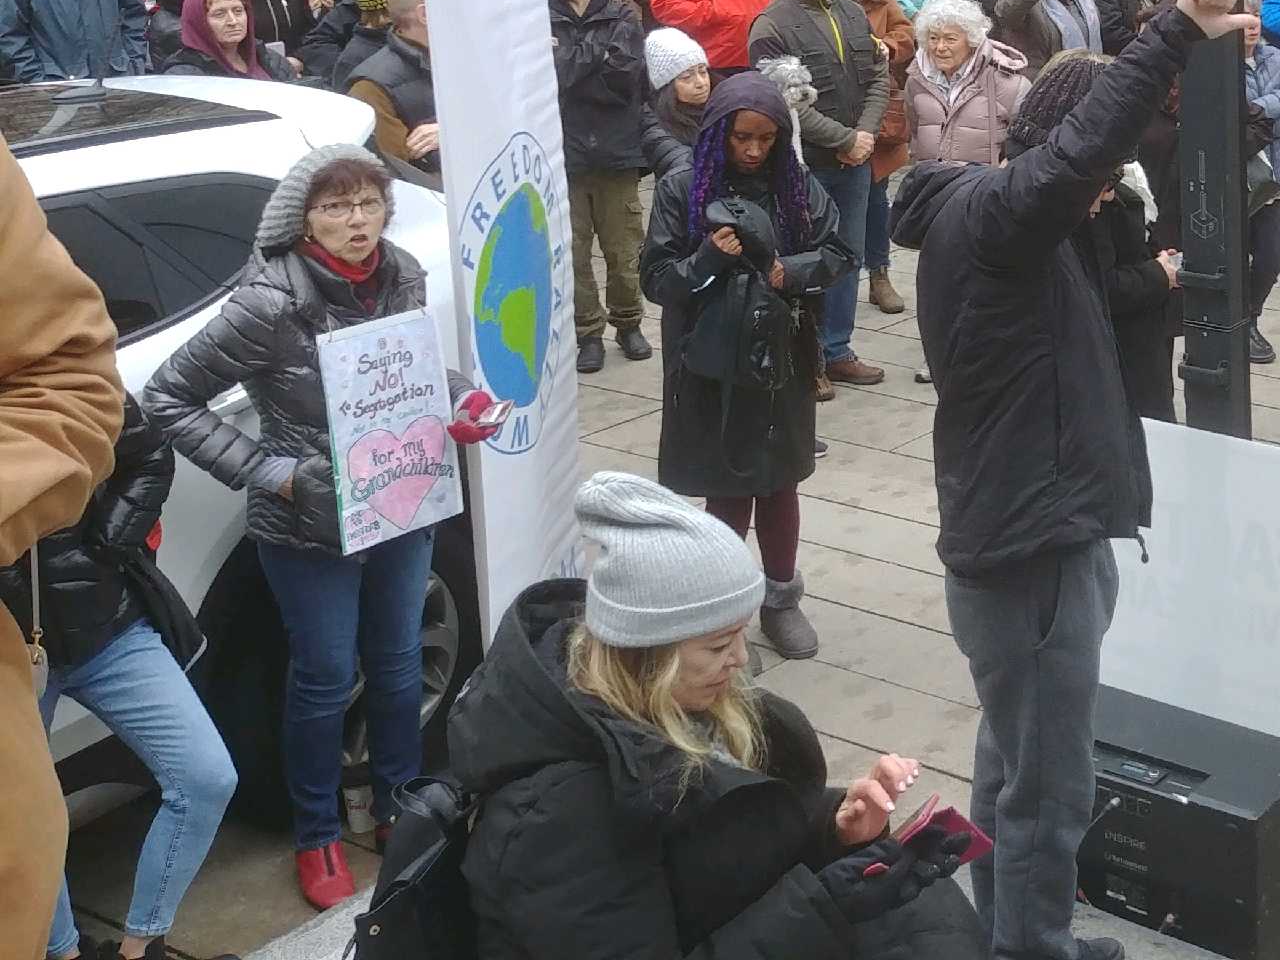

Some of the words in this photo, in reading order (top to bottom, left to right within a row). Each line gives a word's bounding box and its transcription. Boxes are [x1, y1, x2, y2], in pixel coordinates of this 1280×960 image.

[461, 144, 555, 272] FREEDOM
[357, 349, 414, 375] Saying
[371, 448, 396, 466] for
[400, 438, 426, 458] my
[351, 454, 454, 502] Grandchildren
